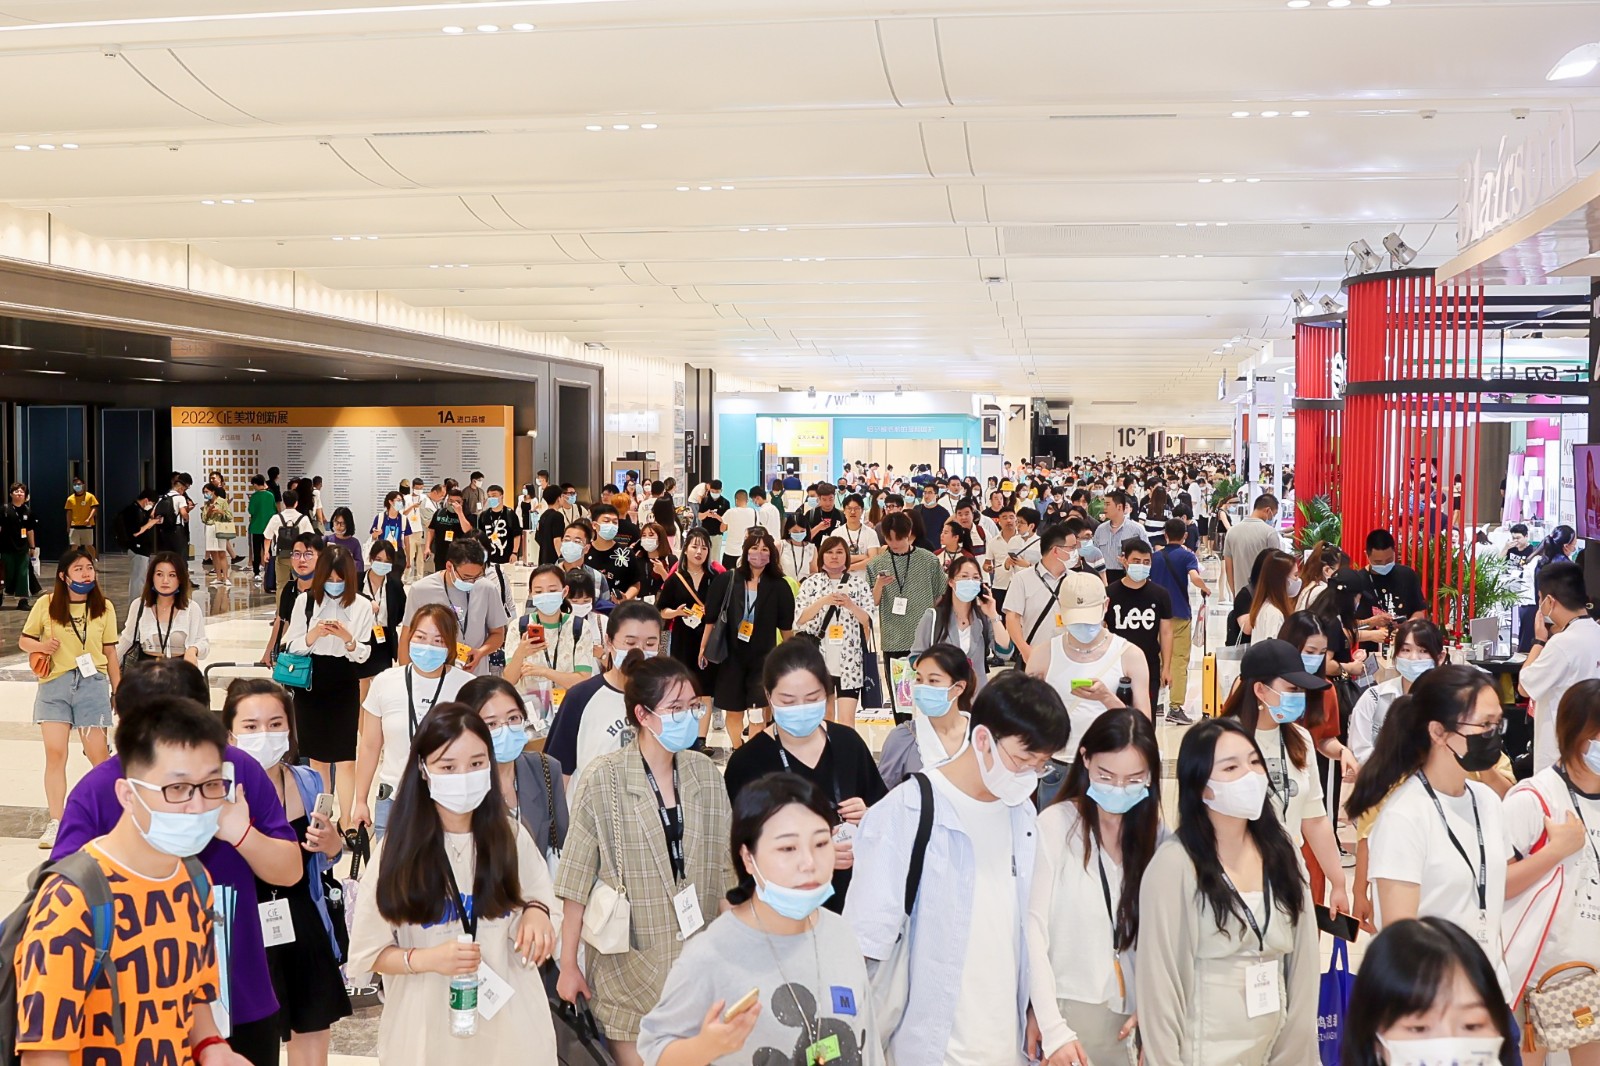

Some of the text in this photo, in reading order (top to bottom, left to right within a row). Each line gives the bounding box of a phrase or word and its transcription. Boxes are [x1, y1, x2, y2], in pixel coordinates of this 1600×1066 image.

[181, 411, 214, 424] 2022
[234, 410, 289, 425] 美妆创新展
[437, 410, 455, 424] 1A
[251, 434, 262, 442] 1A
[1118, 428, 1136, 447] 1C
[1113, 604, 1156, 631] Lee
[840, 995, 851, 1009] M
